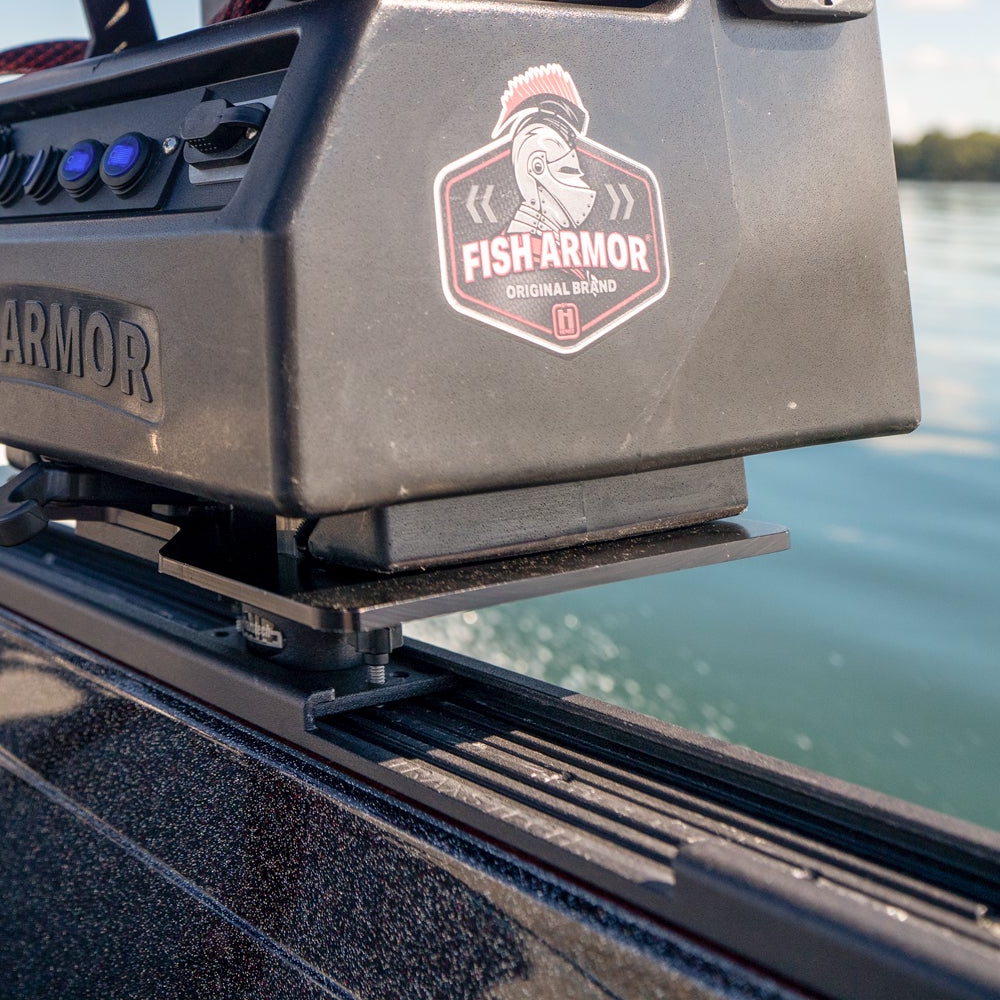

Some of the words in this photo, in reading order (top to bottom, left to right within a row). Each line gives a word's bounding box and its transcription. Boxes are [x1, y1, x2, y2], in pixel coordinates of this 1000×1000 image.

[462, 234, 534, 284] FISH
[539, 230, 651, 273] ARMOR
[506, 281, 571, 299] ORIGINAL
[572, 279, 617, 296] BRAND
[0, 299, 153, 403] ARMOR
